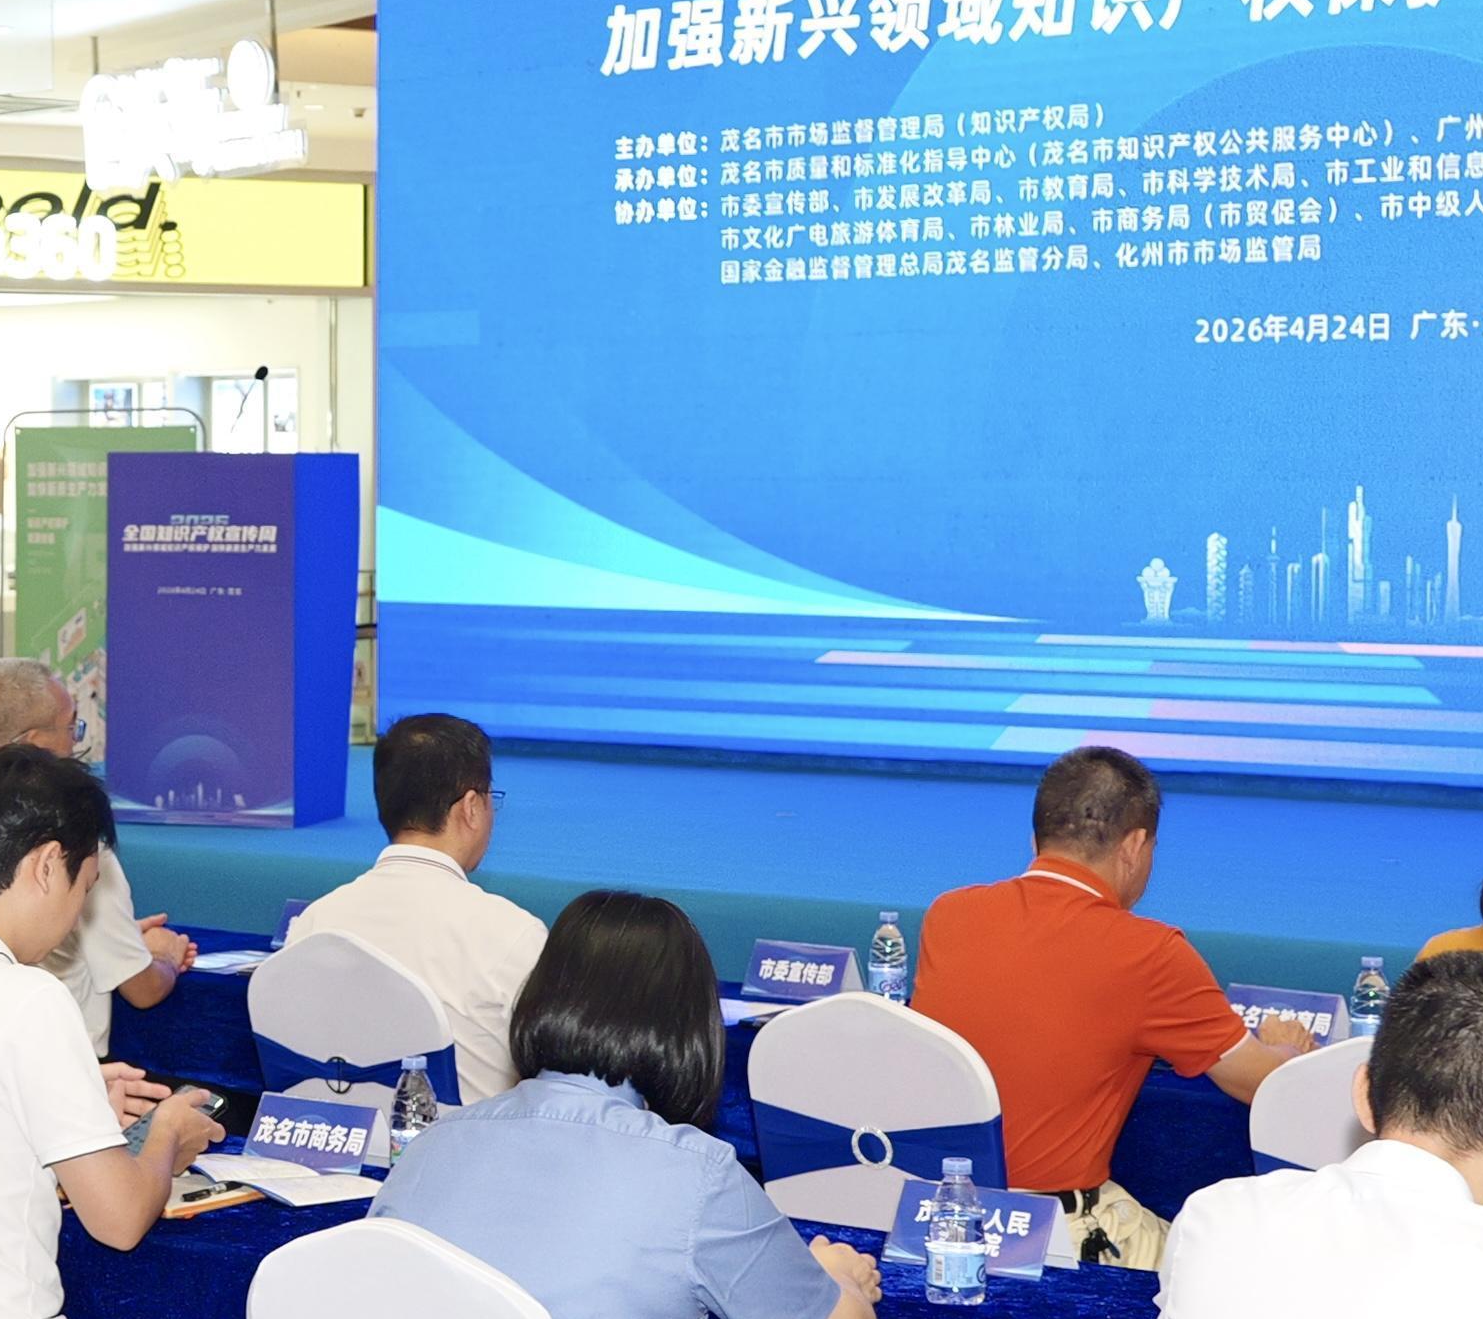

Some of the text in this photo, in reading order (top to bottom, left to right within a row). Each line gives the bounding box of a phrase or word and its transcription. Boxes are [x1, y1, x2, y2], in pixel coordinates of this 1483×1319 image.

[1194, 312, 1391, 344] 2026年4月24日
[758, 957, 835, 987] 市委宣传部
[252, 1114, 368, 1158] 茂名市商务局
